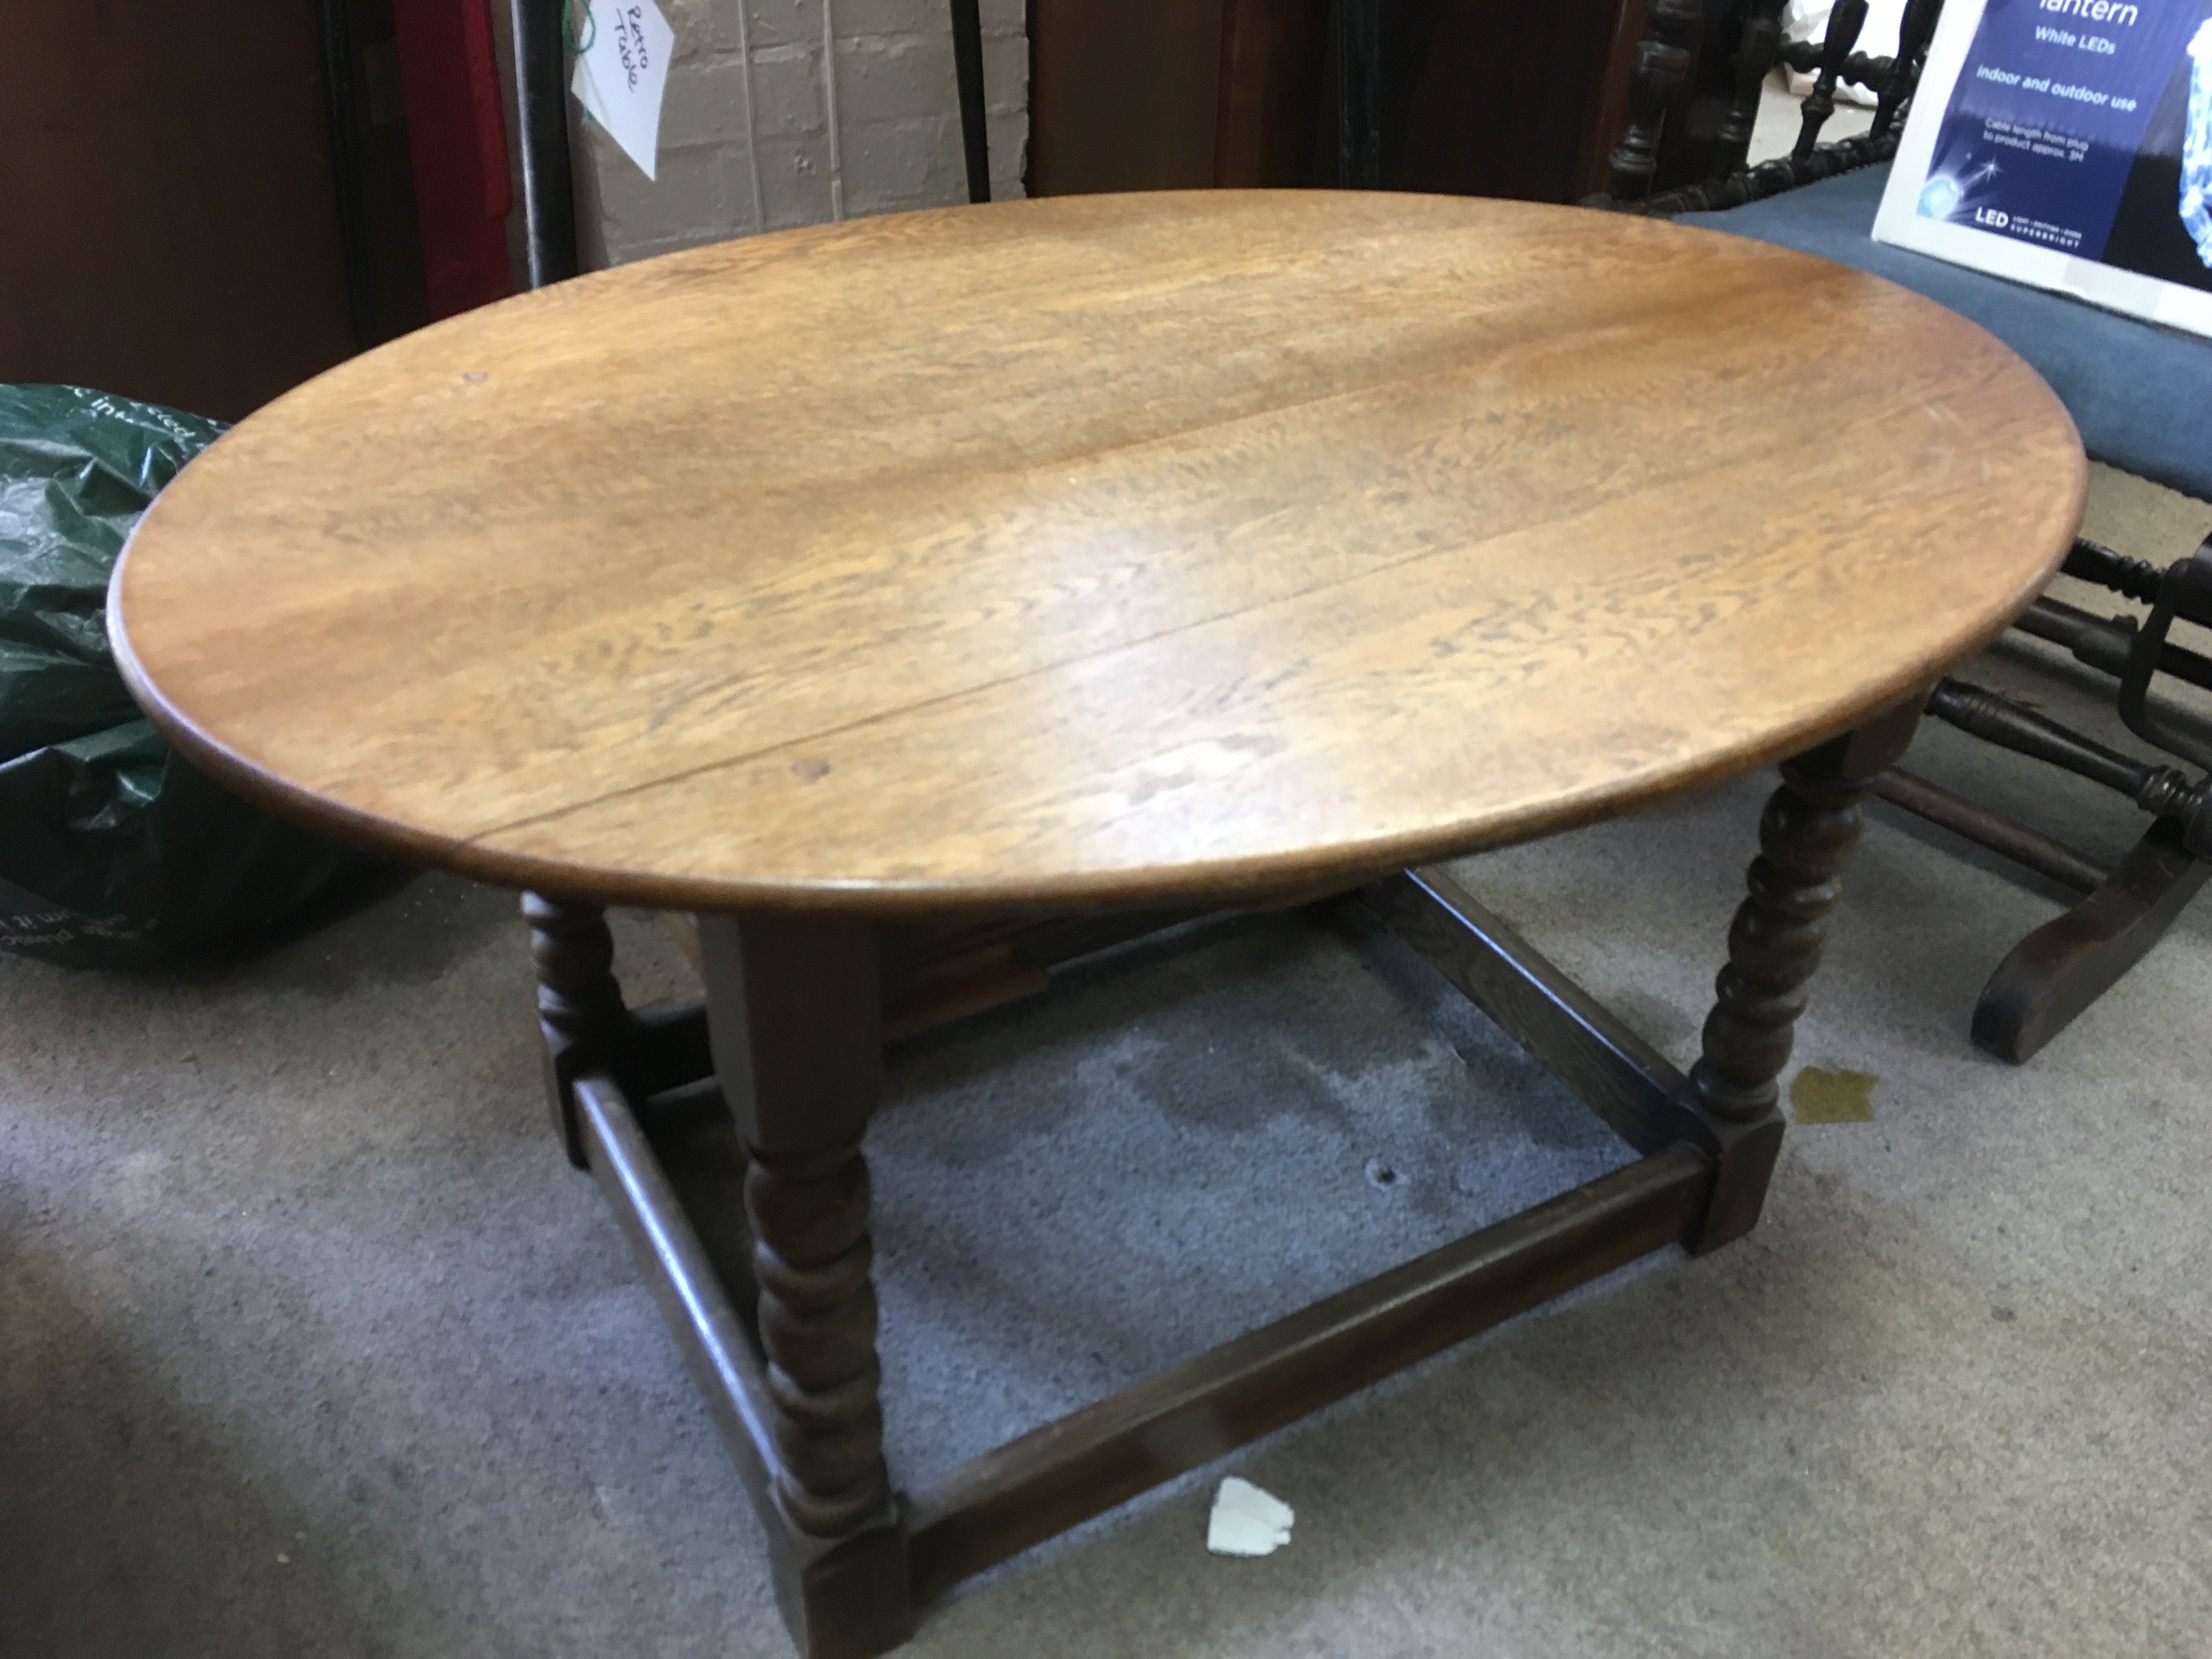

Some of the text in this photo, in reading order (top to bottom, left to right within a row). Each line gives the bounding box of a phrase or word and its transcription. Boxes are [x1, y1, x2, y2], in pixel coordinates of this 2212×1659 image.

[2035, 25, 2117, 55] White LEDs
[1976, 63, 2137, 112] Indoor and outdoor use
[1983, 129, 1994, 142] to
[1994, 133, 2030, 151] product
[1985, 117, 2089, 152] Cable length from plug
[1976, 206, 2009, 229] LED
